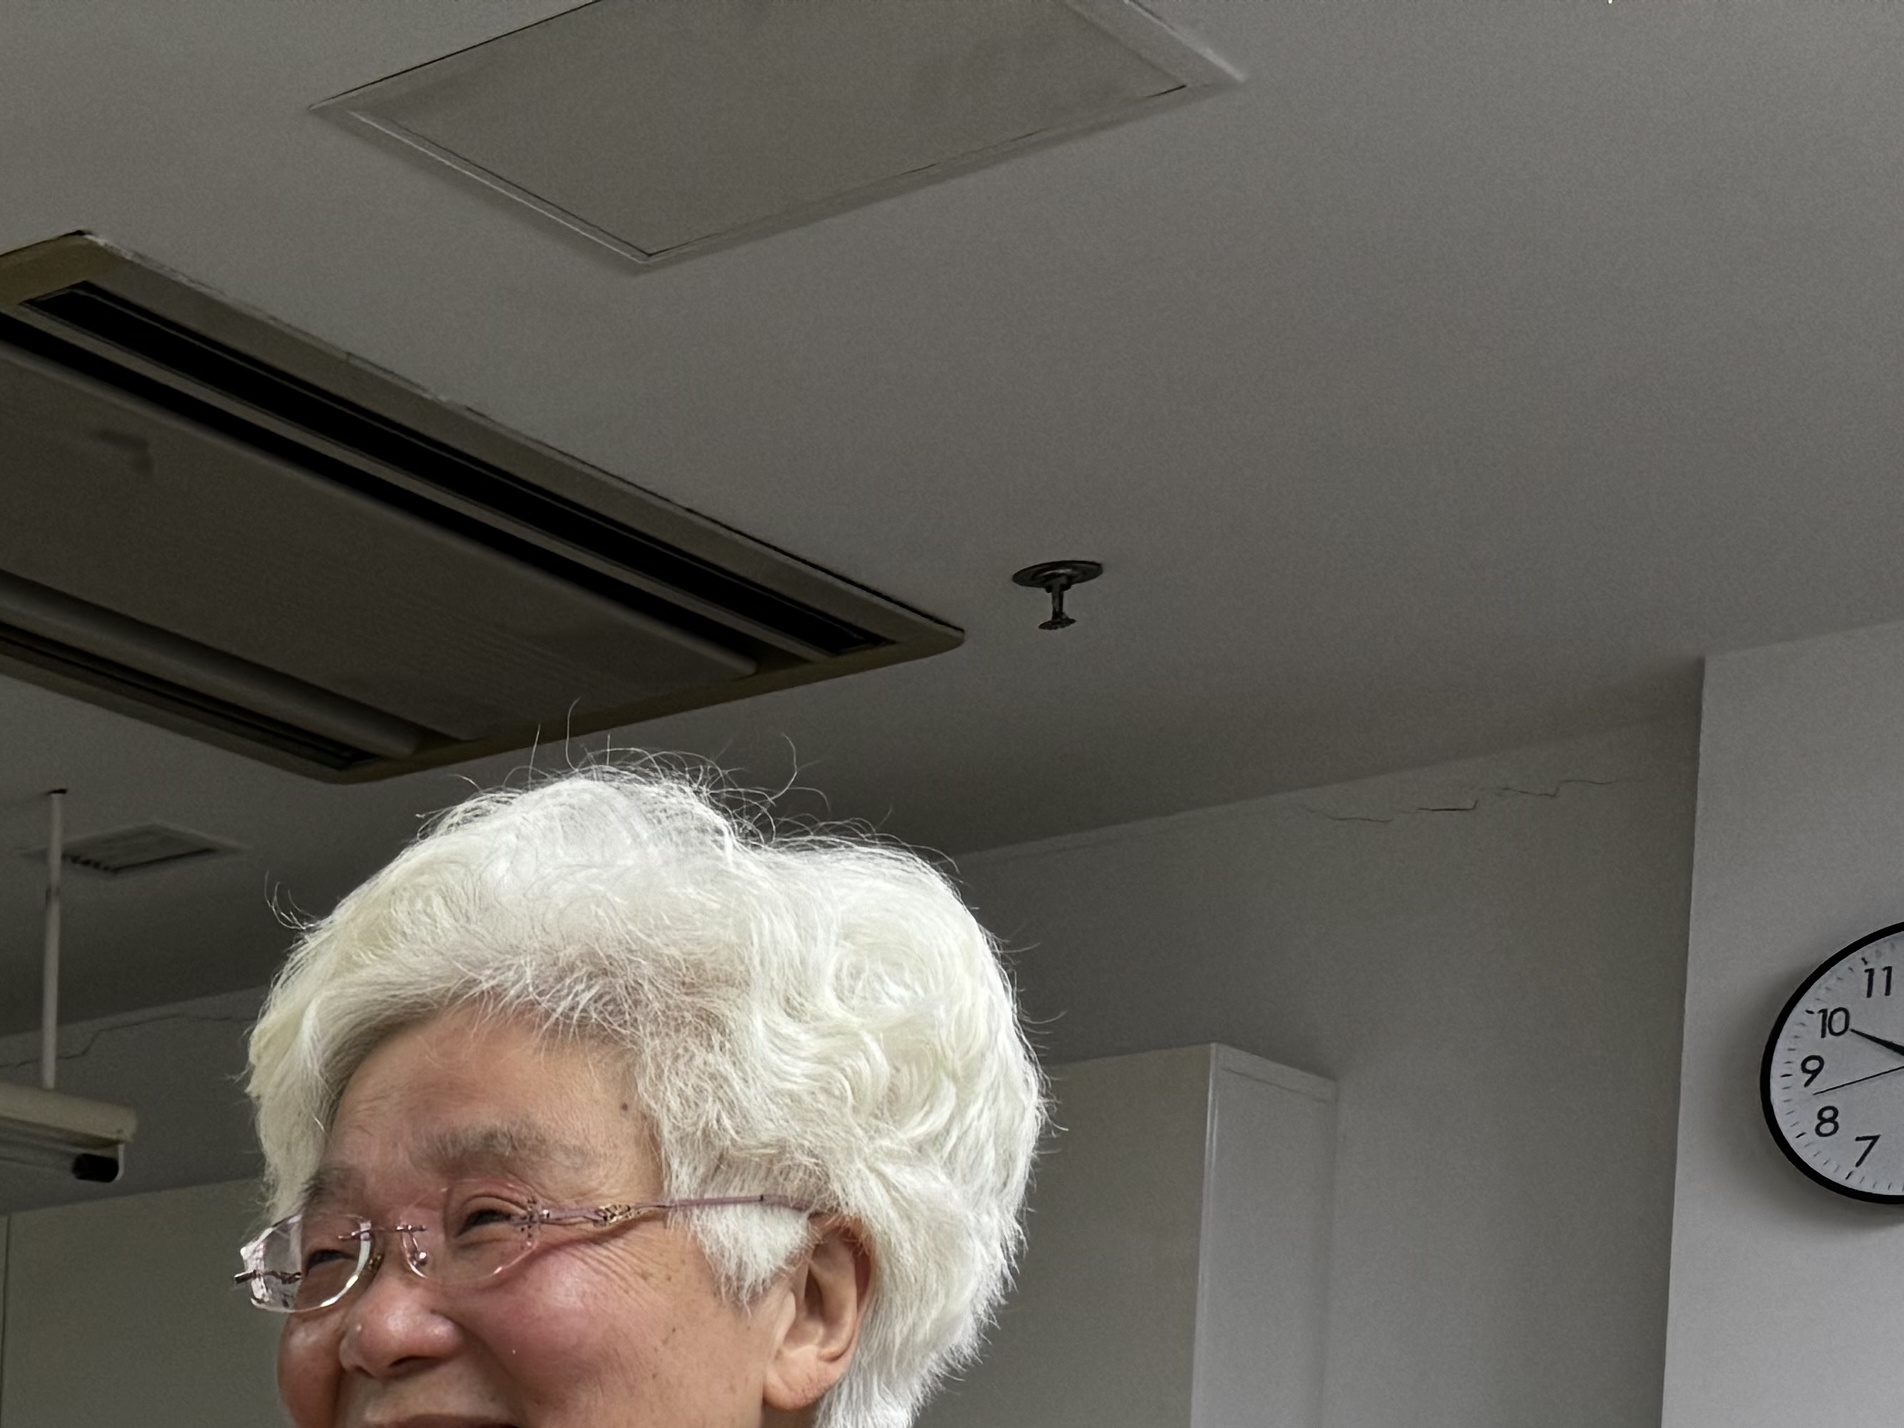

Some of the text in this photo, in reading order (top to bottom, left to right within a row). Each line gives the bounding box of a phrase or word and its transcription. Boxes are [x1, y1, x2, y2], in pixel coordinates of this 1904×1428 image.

[1864, 965, 1893, 998] 11
[1817, 1006, 1850, 1039] 10
[1800, 1054, 1825, 1088] 9
[1814, 1105, 1840, 1138] 8
[1854, 1134, 1881, 1168] 7
